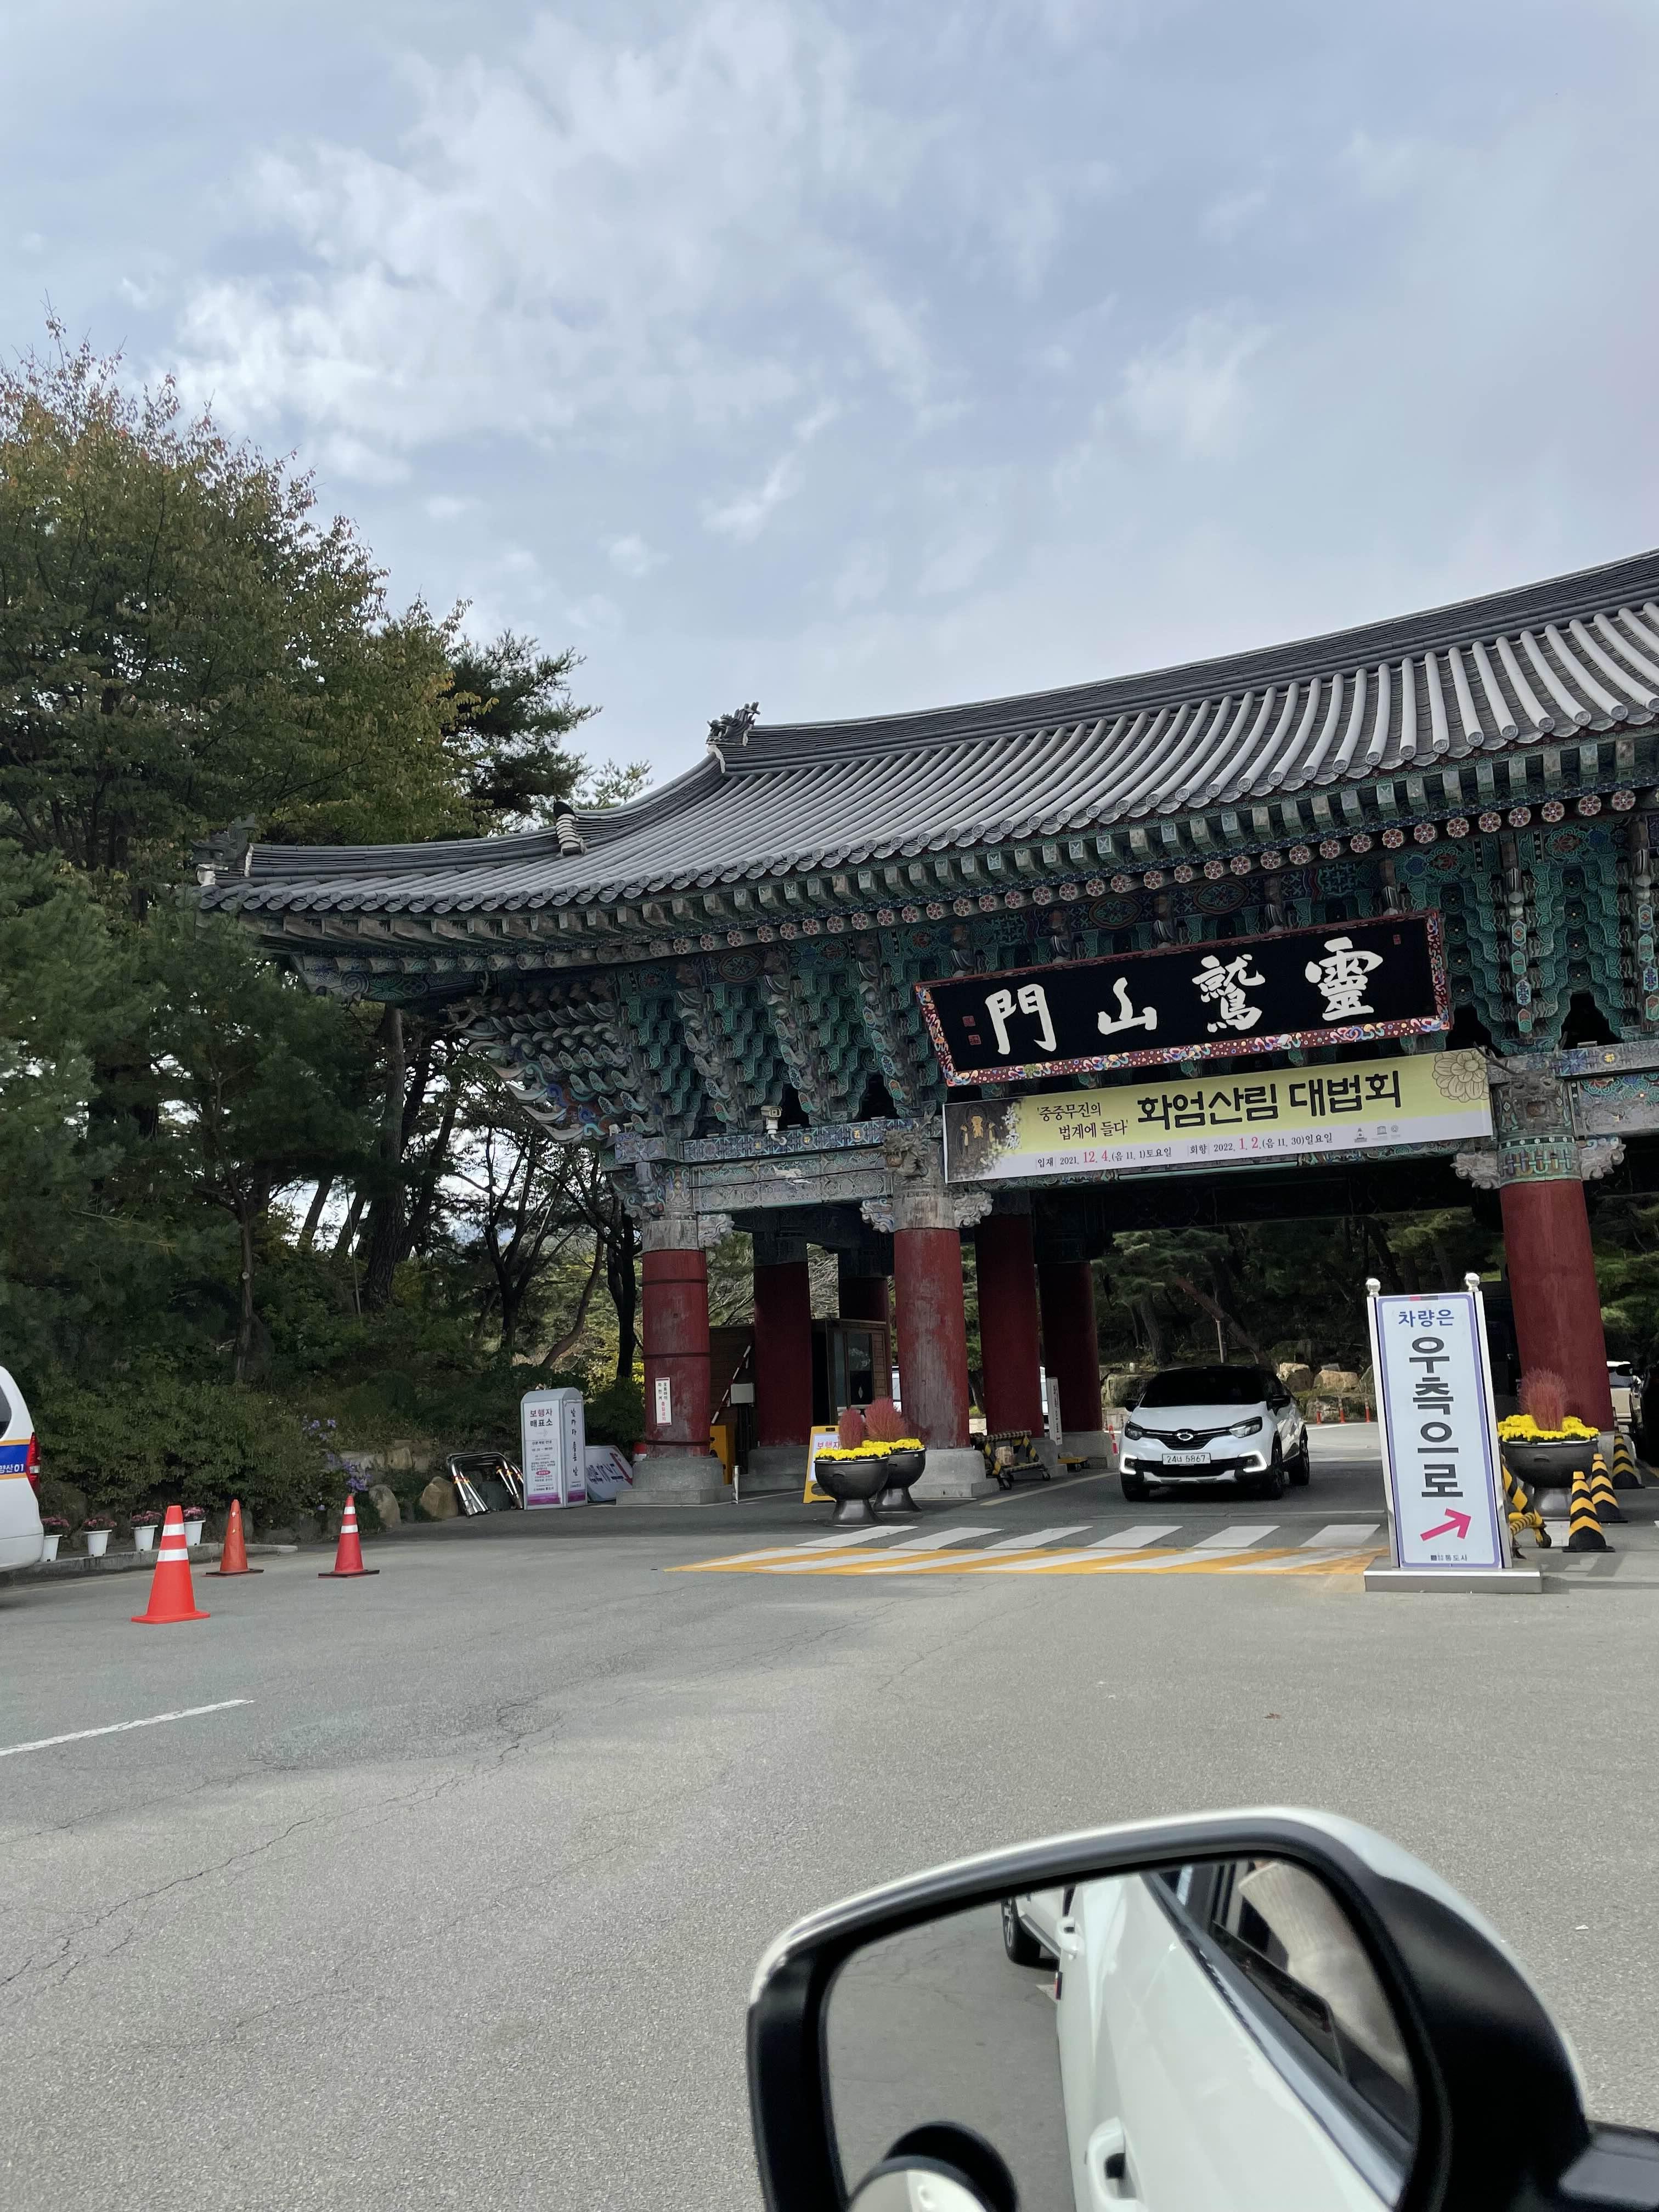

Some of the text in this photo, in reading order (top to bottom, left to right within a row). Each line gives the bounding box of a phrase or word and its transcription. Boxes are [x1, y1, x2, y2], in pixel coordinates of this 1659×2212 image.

[1137, 1070, 1401, 1130] 화엄산림 대법회
[1059, 1123, 1097, 1141] 법계에
[1190, 1144, 1207, 1154] 회향
[1037, 1158, 1053, 1168] 입재
[1398, 1309, 1455, 1328] 차량은
[530, 1408, 552, 1417] 보행자
[1409, 1337, 1464, 1498] 우측으로
[530, 1419, 553, 1427] 매표소
[1186, 1454, 1205, 1463] 5867
